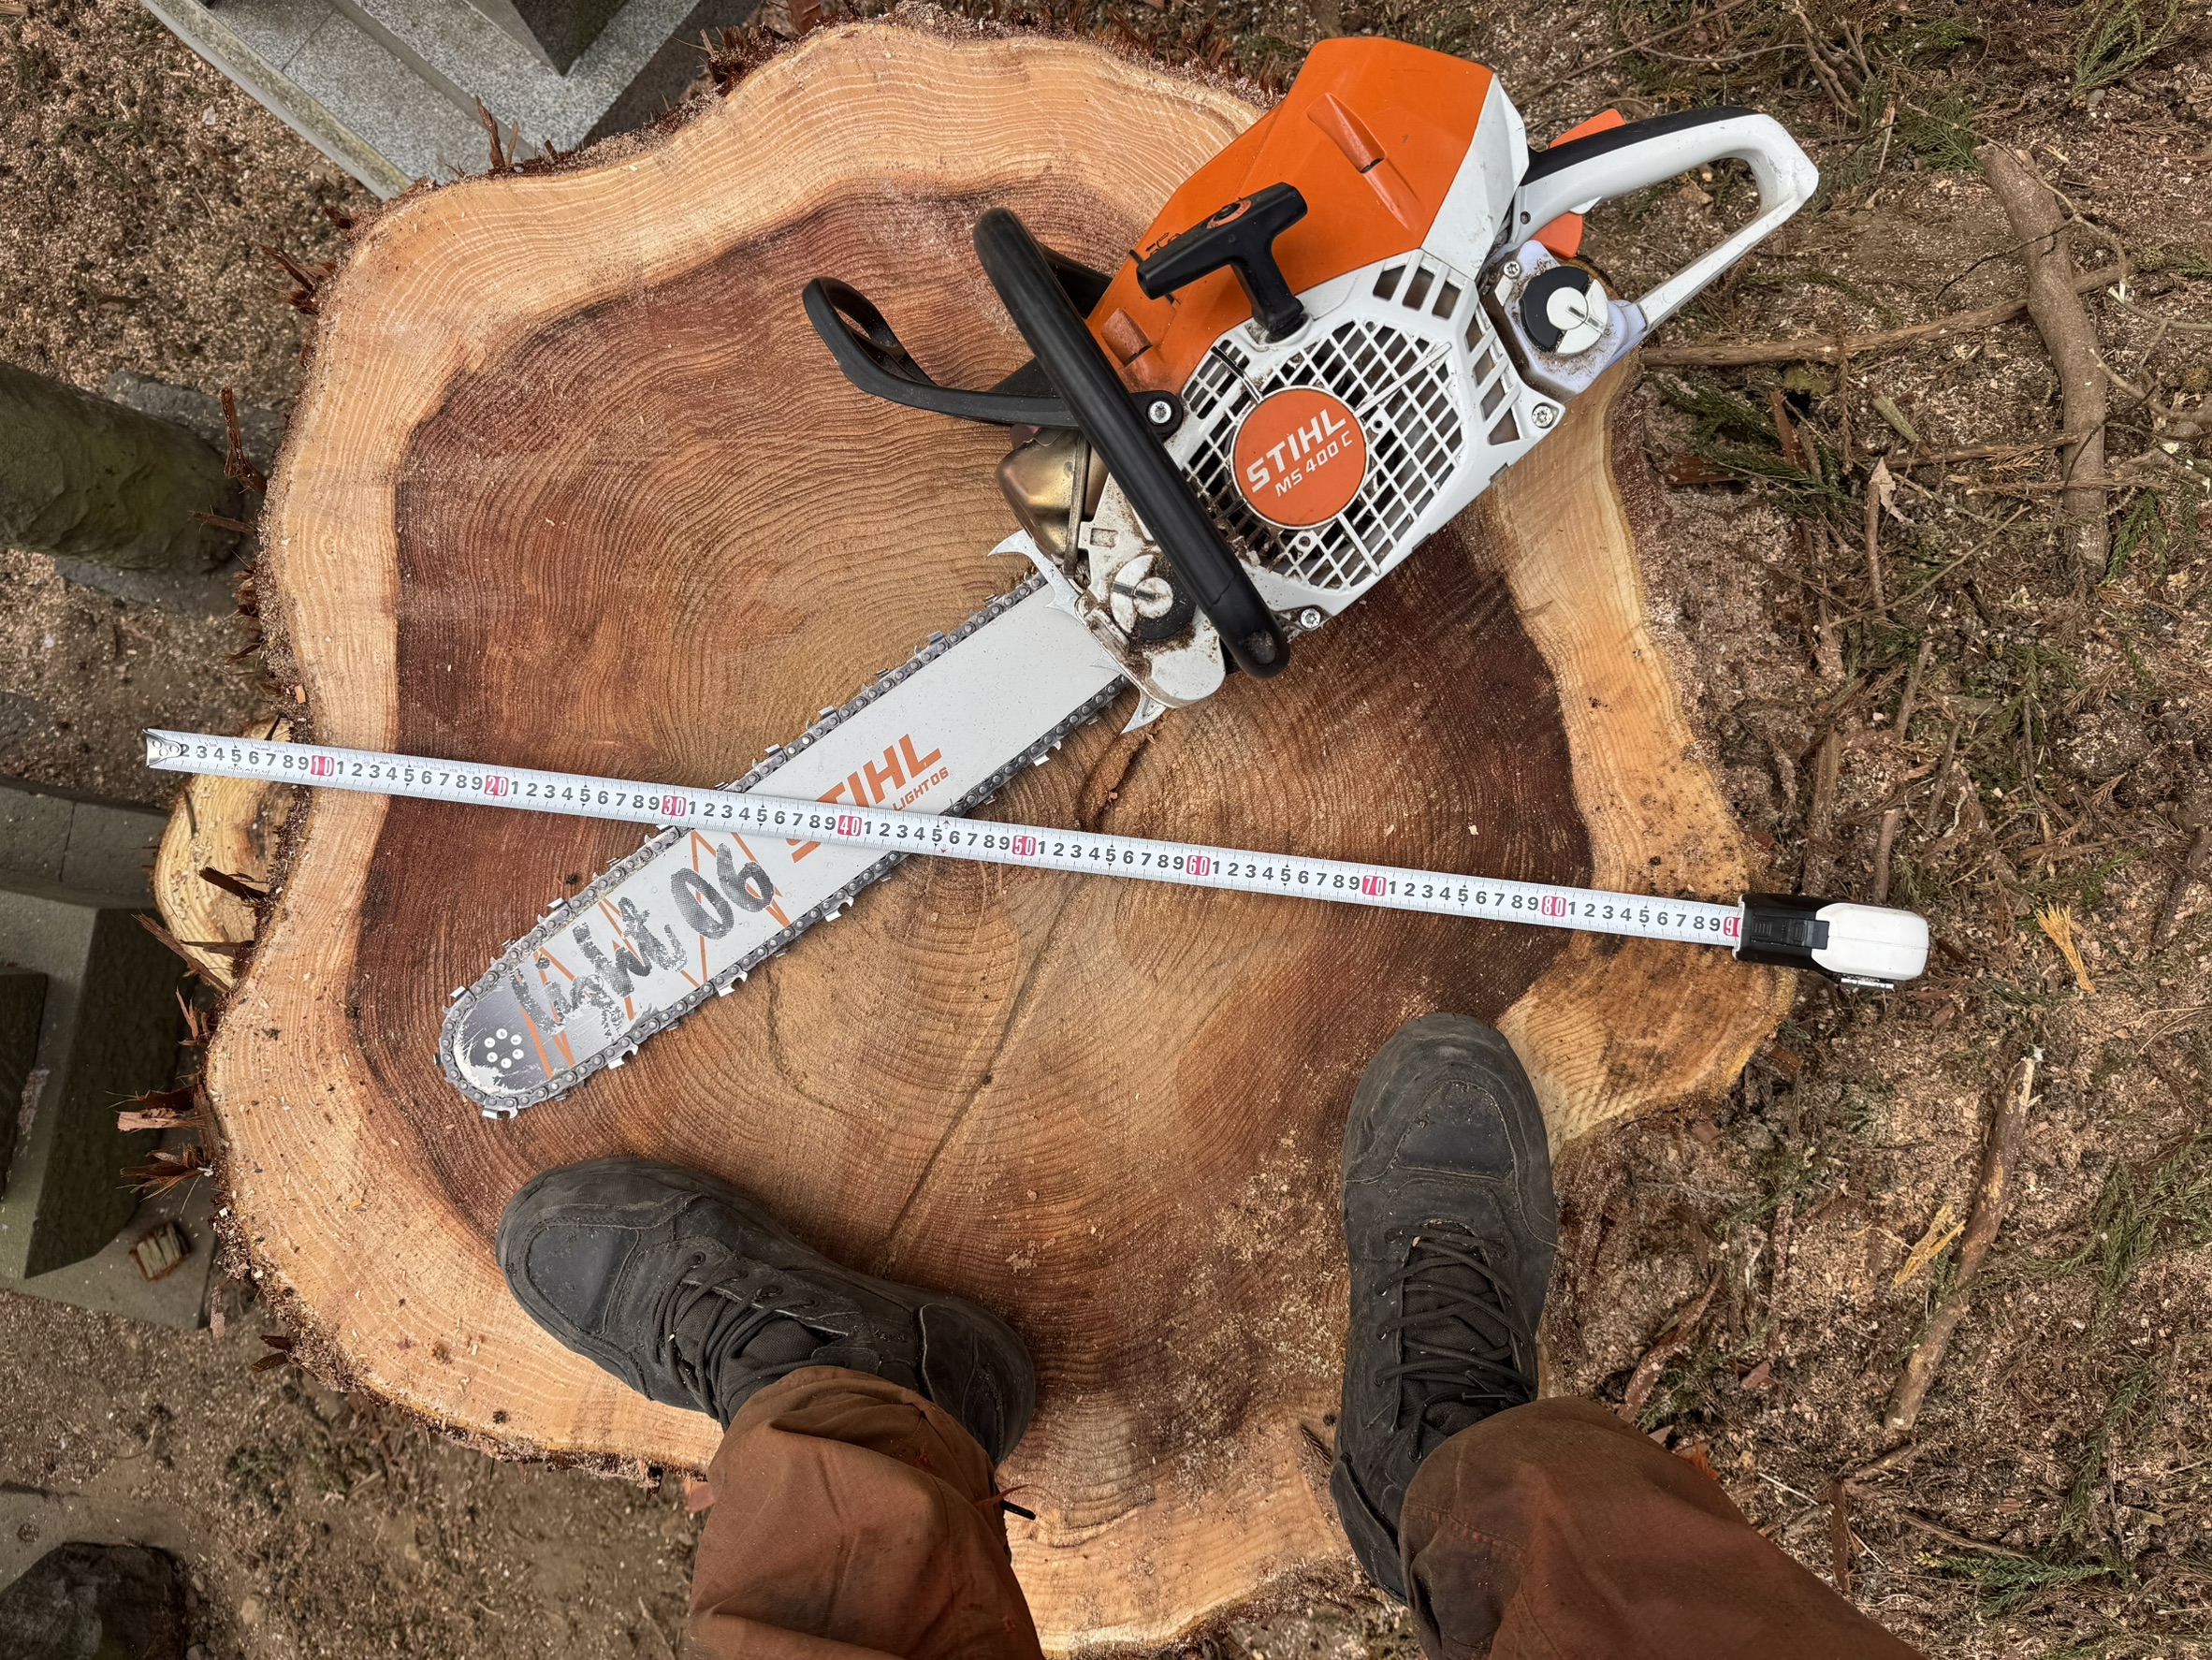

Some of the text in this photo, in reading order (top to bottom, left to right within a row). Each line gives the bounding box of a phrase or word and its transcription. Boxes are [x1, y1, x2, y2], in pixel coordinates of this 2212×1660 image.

[1246, 409, 1346, 493] STIHL
[1274, 430, 1353, 497] MS 400 C
[181, 744, 190, 757] 2
[196, 745, 207, 758] 3
[213, 747, 225, 761] 4
[231, 749, 241, 762] 5
[249, 750, 258, 764] 6
[266, 752, 275, 765] 7
[283, 754, 293, 768] 8
[298, 756, 308, 770] 9
[313, 756, 333, 777] 10
[337, 761, 343, 774] 1
[351, 763, 362, 777] 2
[369, 764, 380, 779] 3
[386, 766, 397, 780] 4
[403, 768, 414, 782] 5
[421, 770, 431, 784] 6
[439, 772, 449, 785] 7
[456, 774, 467, 788] 8
[471, 776, 482, 790] 9
[487, 776, 508, 796] 20
[511, 780, 517, 794] 1
[526, 782, 537, 796] 2
[544, 784, 555, 798] 3
[561, 787, 573, 800] 4
[579, 788, 589, 802] 5
[597, 790, 608, 805] 6
[616, 793, 626, 806] 7
[632, 794, 644, 808] 8
[648, 796, 660, 810] 9
[664, 796, 685, 817] 30
[689, 800, 695, 814] 1
[703, 802, 715, 817] 2
[720, 804, 733, 819] 3
[738, 807, 749, 821] 4
[756, 808, 767, 823] 5
[774, 810, 785, 824] 6
[793, 812, 803, 825] 7
[808, 814, 820, 828] 8
[824, 816, 836, 830] 9
[840, 816, 861, 837] 40
[864, 821, 871, 834] 1
[879, 823, 890, 837] 2
[896, 824, 908, 838] 3
[913, 826, 924, 840] 4
[931, 828, 942, 842] 5
[949, 830, 960, 844] 6
[968, 832, 977, 846] 7
[983, 834, 995, 848] 8
[998, 836, 1010, 850] 9
[1014, 836, 1034, 856] 50
[1038, 840, 1045, 854] 1
[1053, 842, 1064, 856] 2
[1070, 844, 1082, 858] 3
[1088, 847, 1099, 860] 4
[1105, 848, 1115, 862] 5
[1123, 850, 1133, 864] 6
[1141, 852, 1151, 866] 7
[1157, 854, 1169, 868] 8
[1172, 855, 1184, 869] 9
[1188, 856, 1209, 877] 60
[1212, 860, 1219, 874] 1
[1227, 862, 1238, 876] 2
[1244, 864, 1256, 878] 3
[1261, 866, 1273, 880] 4
[1280, 867, 1290, 881] 5
[1298, 870, 1308, 884] 6
[1317, 872, 1327, 885] 7
[1332, 874, 1344, 888] 8
[1348, 876, 1360, 890] 9
[1364, 876, 1385, 896] 70
[1389, 881, 1396, 895] 1
[1404, 882, 1415, 896] 2
[1421, 884, 1433, 898] 3
[1439, 886, 1450, 900] 4
[1458, 888, 1468, 902] 5
[1476, 891, 1486, 904] 6
[1494, 893, 1505, 906] 7
[1511, 895, 1522, 909] 8
[1527, 896, 1538, 910] 9
[1543, 896, 1564, 917] 80
[1568, 901, 1575, 915] 1
[1584, 903, 1595, 917] 2
[1602, 905, 1613, 919] 3
[1620, 908, 1632, 921] 4
[1638, 909, 1649, 923] 5
[1657, 911, 1667, 925] 6
[1676, 913, 1686, 926] 7
[1693, 915, 1704, 929] 8
[1709, 917, 1720, 931] 9
[671, 843, 775, 939] 06
